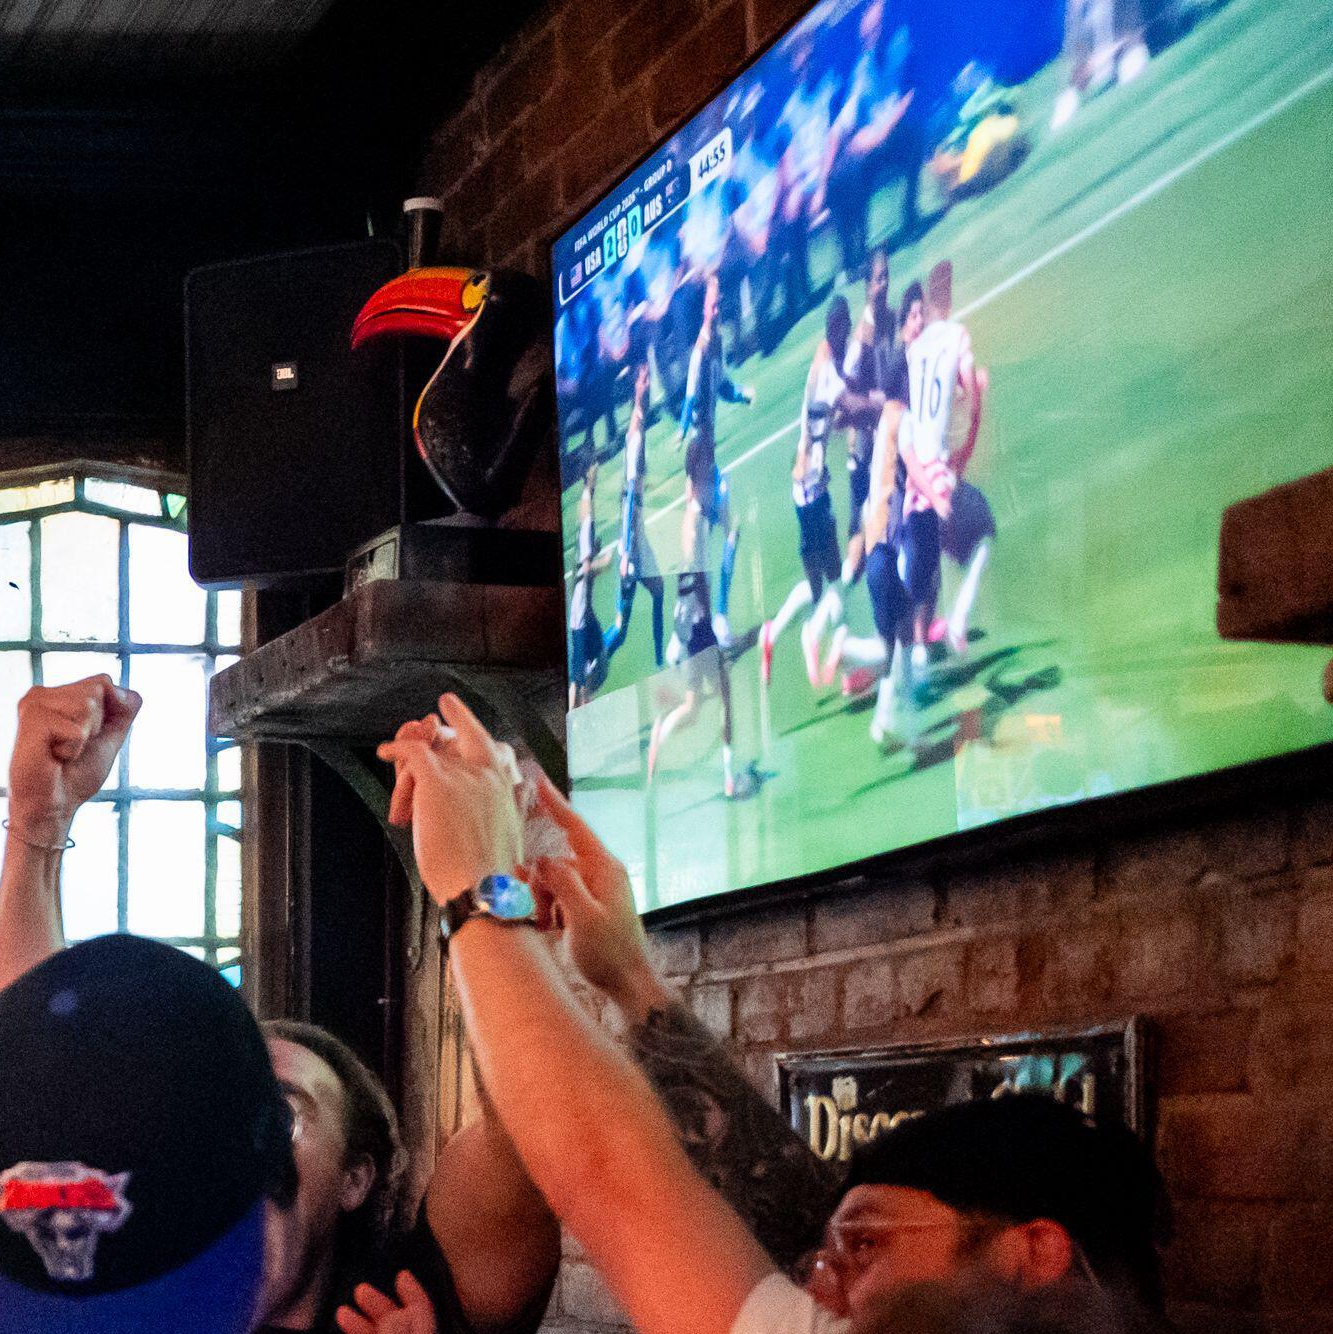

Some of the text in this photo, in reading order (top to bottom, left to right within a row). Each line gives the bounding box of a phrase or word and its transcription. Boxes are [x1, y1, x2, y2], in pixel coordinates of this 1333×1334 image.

[584, 246, 601, 276] USA
[644, 193, 662, 227] AUS
[608, 204, 621, 222] CUP
[919, 347, 947, 424] 16
